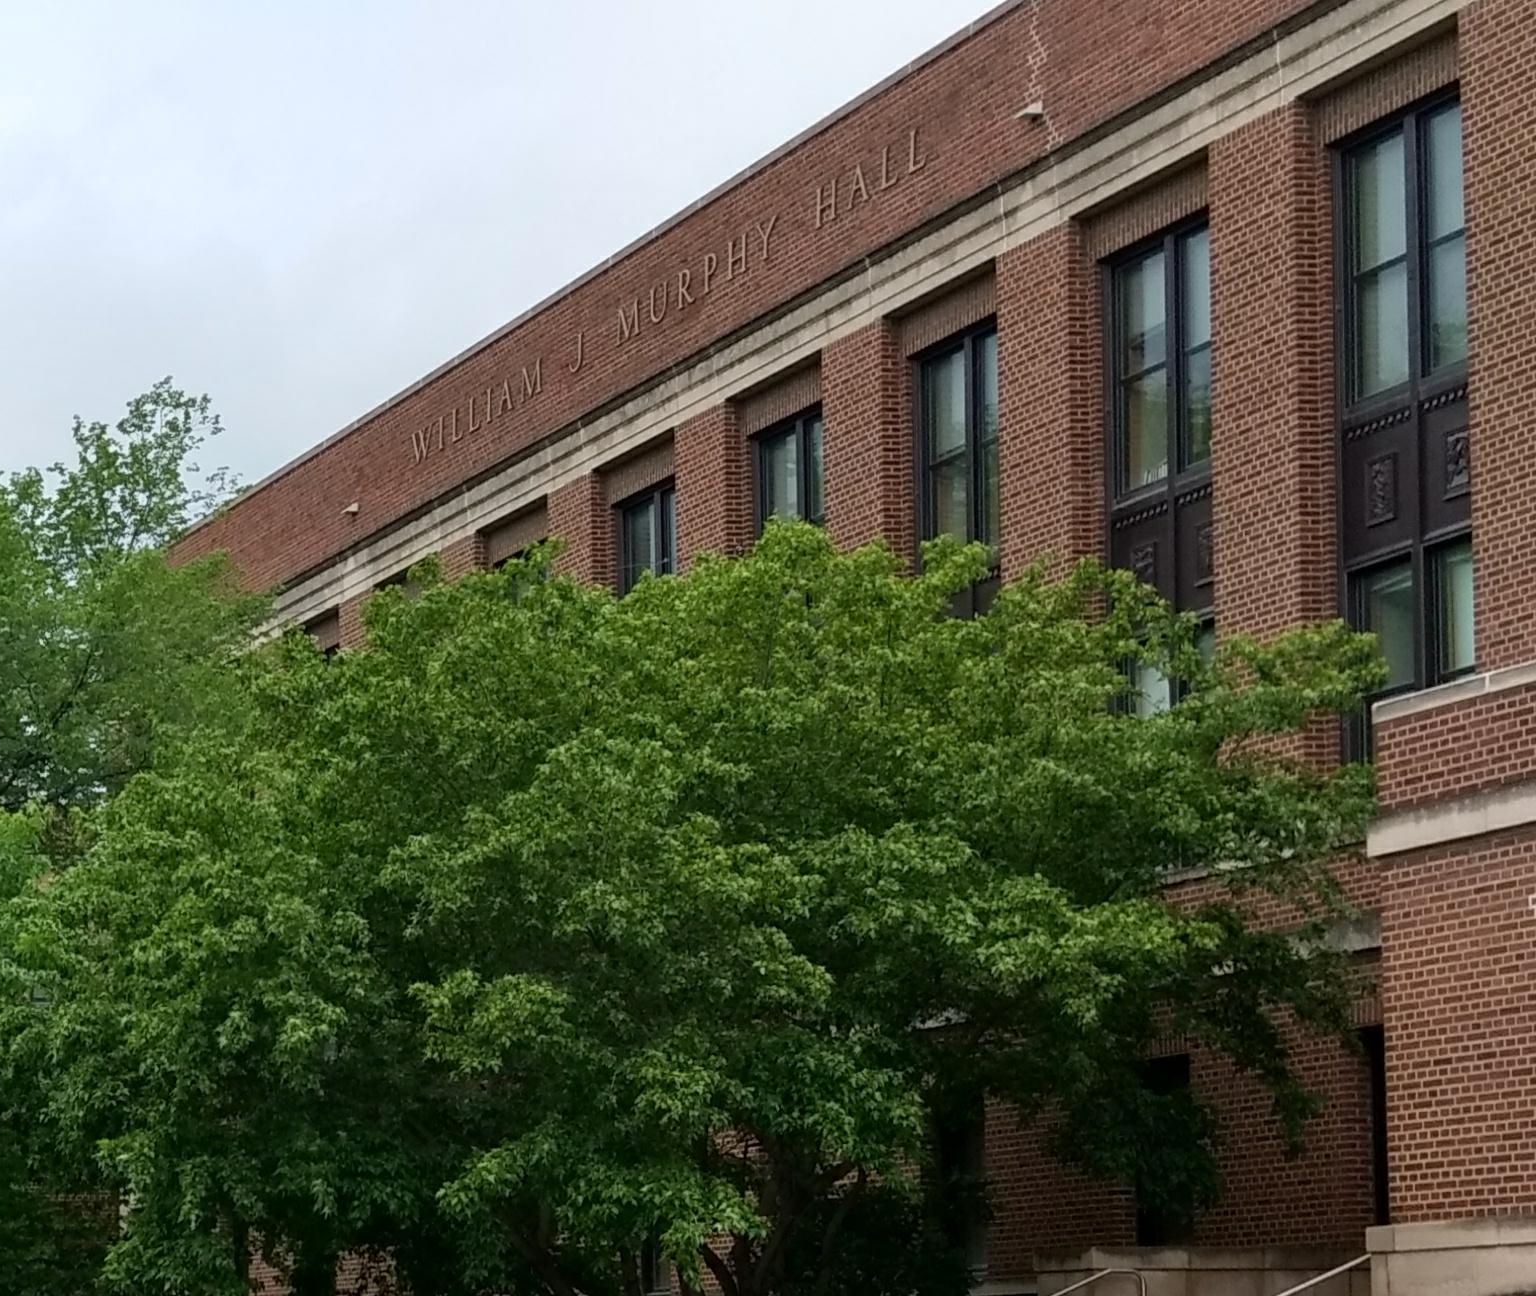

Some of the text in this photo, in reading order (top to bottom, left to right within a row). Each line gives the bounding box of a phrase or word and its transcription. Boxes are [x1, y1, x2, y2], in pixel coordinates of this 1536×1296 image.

[410, 359, 544, 464] WILLIAM
[616, 216, 778, 346] MURPHY
[815, 128, 928, 228] HALL
